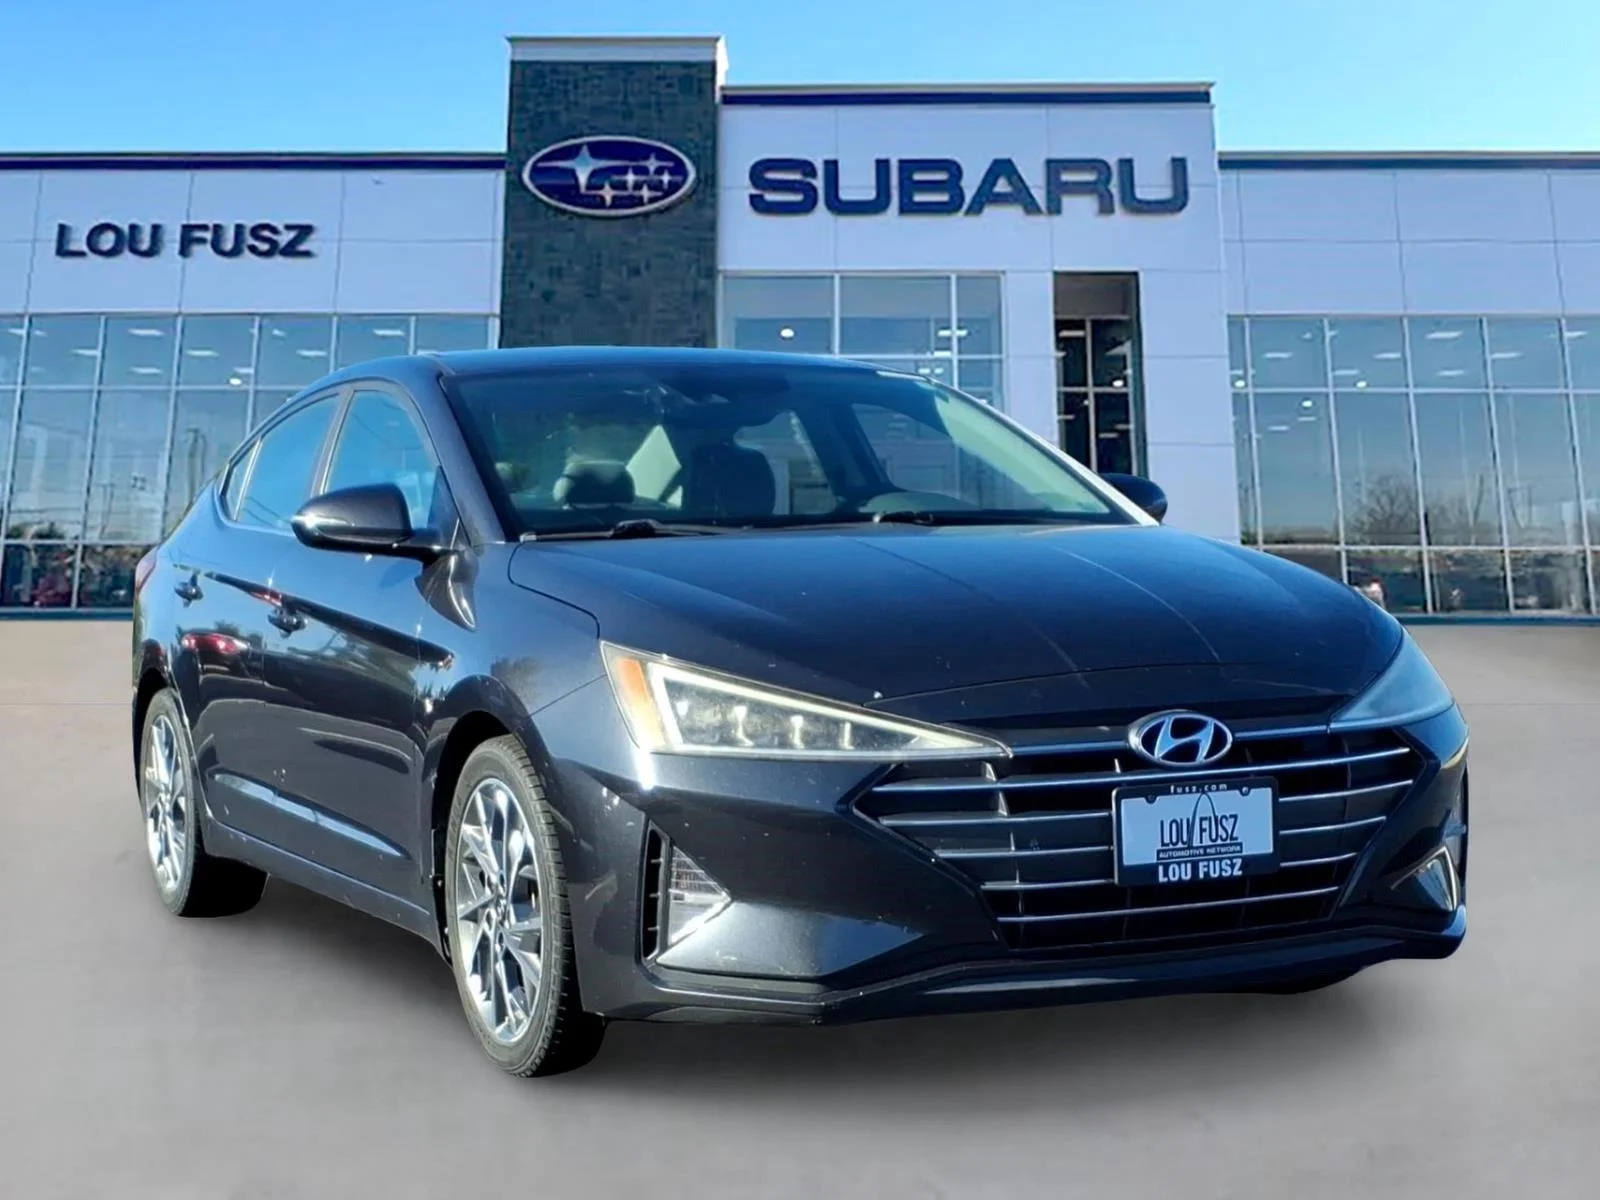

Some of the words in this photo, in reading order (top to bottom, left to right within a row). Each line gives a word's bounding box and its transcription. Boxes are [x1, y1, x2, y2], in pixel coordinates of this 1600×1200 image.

[748, 155, 1190, 216] SUBARU
[55, 221, 164, 258] LOU
[178, 222, 316, 258] FUSZ
[1170, 783, 1228, 794] fusz.com
[1160, 816, 1190, 848] LOU
[1199, 814, 1239, 845] FUSZ
[1158, 848, 1204, 859] AUTOMOTIVE
[1206, 845, 1241, 855] NETWORK
[1158, 862, 1192, 883] LOU
[1199, 858, 1243, 879] FUSZ
